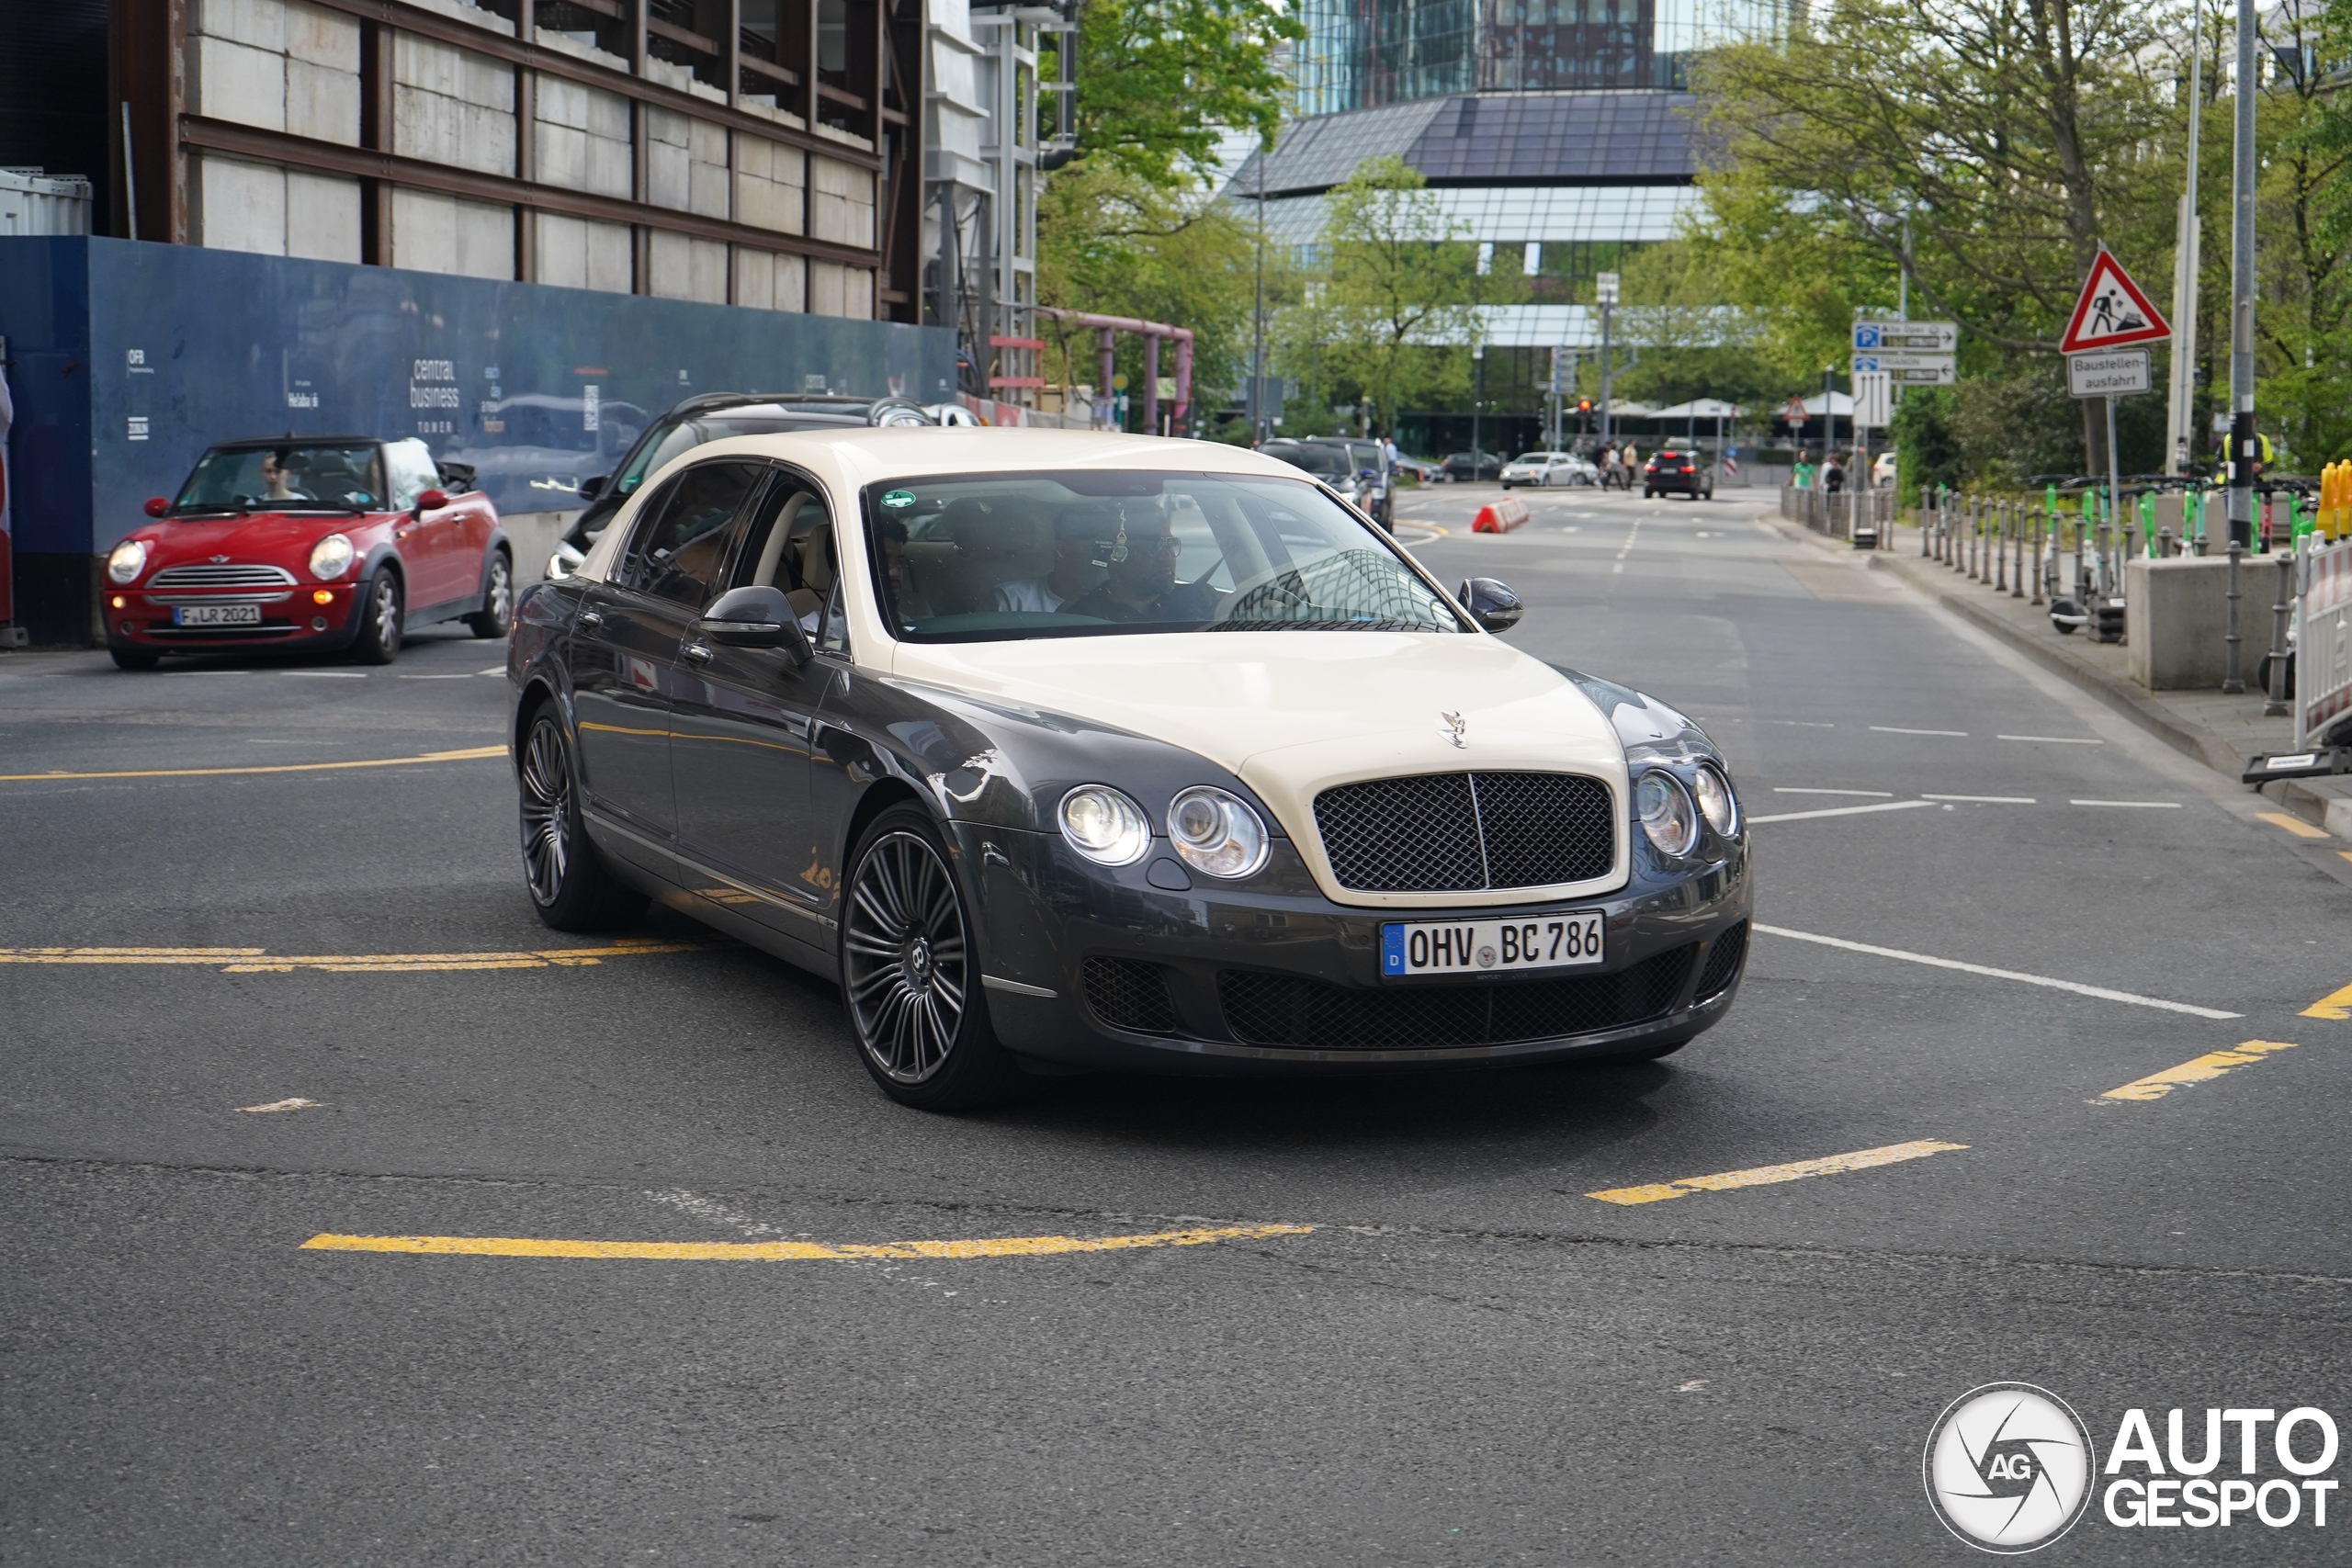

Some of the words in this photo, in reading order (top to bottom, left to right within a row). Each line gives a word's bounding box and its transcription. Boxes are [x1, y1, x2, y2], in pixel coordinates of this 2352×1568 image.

[129, 349, 144, 365] OFB
[2075, 357, 2145, 372] Baustellen-
[413, 358, 456, 380] central
[2085, 374, 2136, 389] ausfahrt
[410, 377, 459, 409] business
[417, 421, 452, 434] TOWER
[182, 609, 190, 623] F
[199, 609, 219, 623] LR
[221, 607, 257, 622] 2021
[1409, 927, 1474, 968] OHV
[1501, 923, 1539, 964] BC
[1548, 919, 1599, 961] 786
[1389, 954, 1399, 966] D
